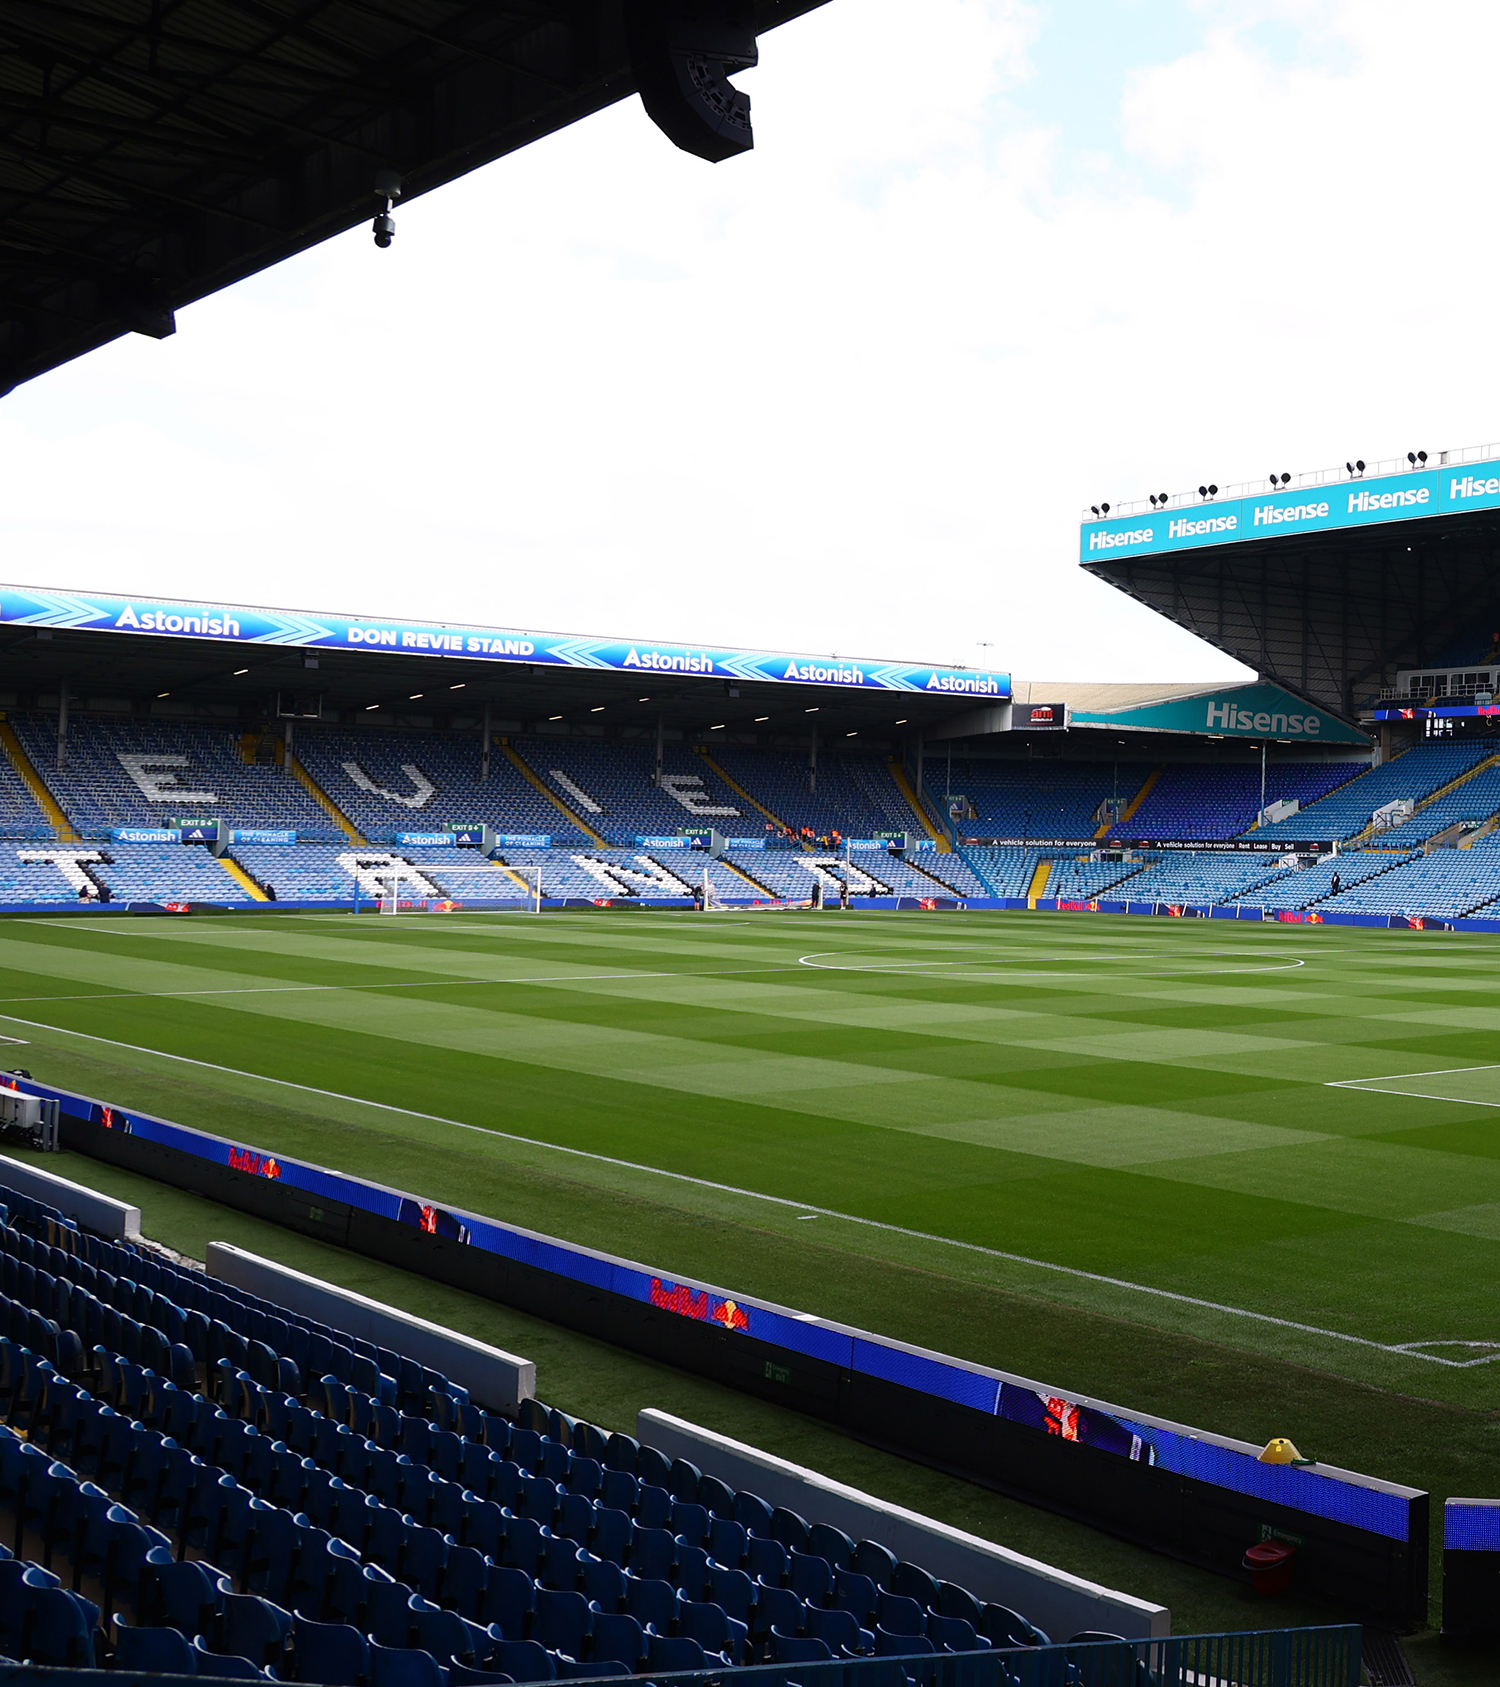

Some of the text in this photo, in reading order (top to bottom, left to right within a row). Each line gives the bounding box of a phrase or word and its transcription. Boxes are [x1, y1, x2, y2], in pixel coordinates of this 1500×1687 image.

[1347, 487, 1430, 514] Hisense
[1253, 501, 1330, 526] Hisense
[1168, 515, 1238, 539] Hisense
[1089, 528, 1154, 551] Hisense
[115, 605, 240, 637] Astonish
[347, 626, 535, 656] DON REVIE STAND
[622, 646, 714, 673] Astonish
[783, 659, 864, 684] Astonish
[926, 671, 998, 694] Astonish
[1206, 701, 1320, 734] Hisense
[117, 830, 176, 842] Astonish
[402, 834, 451, 846] Astonish
[643, 838, 684, 847] Astonish
[1271, 843, 1281, 851] Buy
